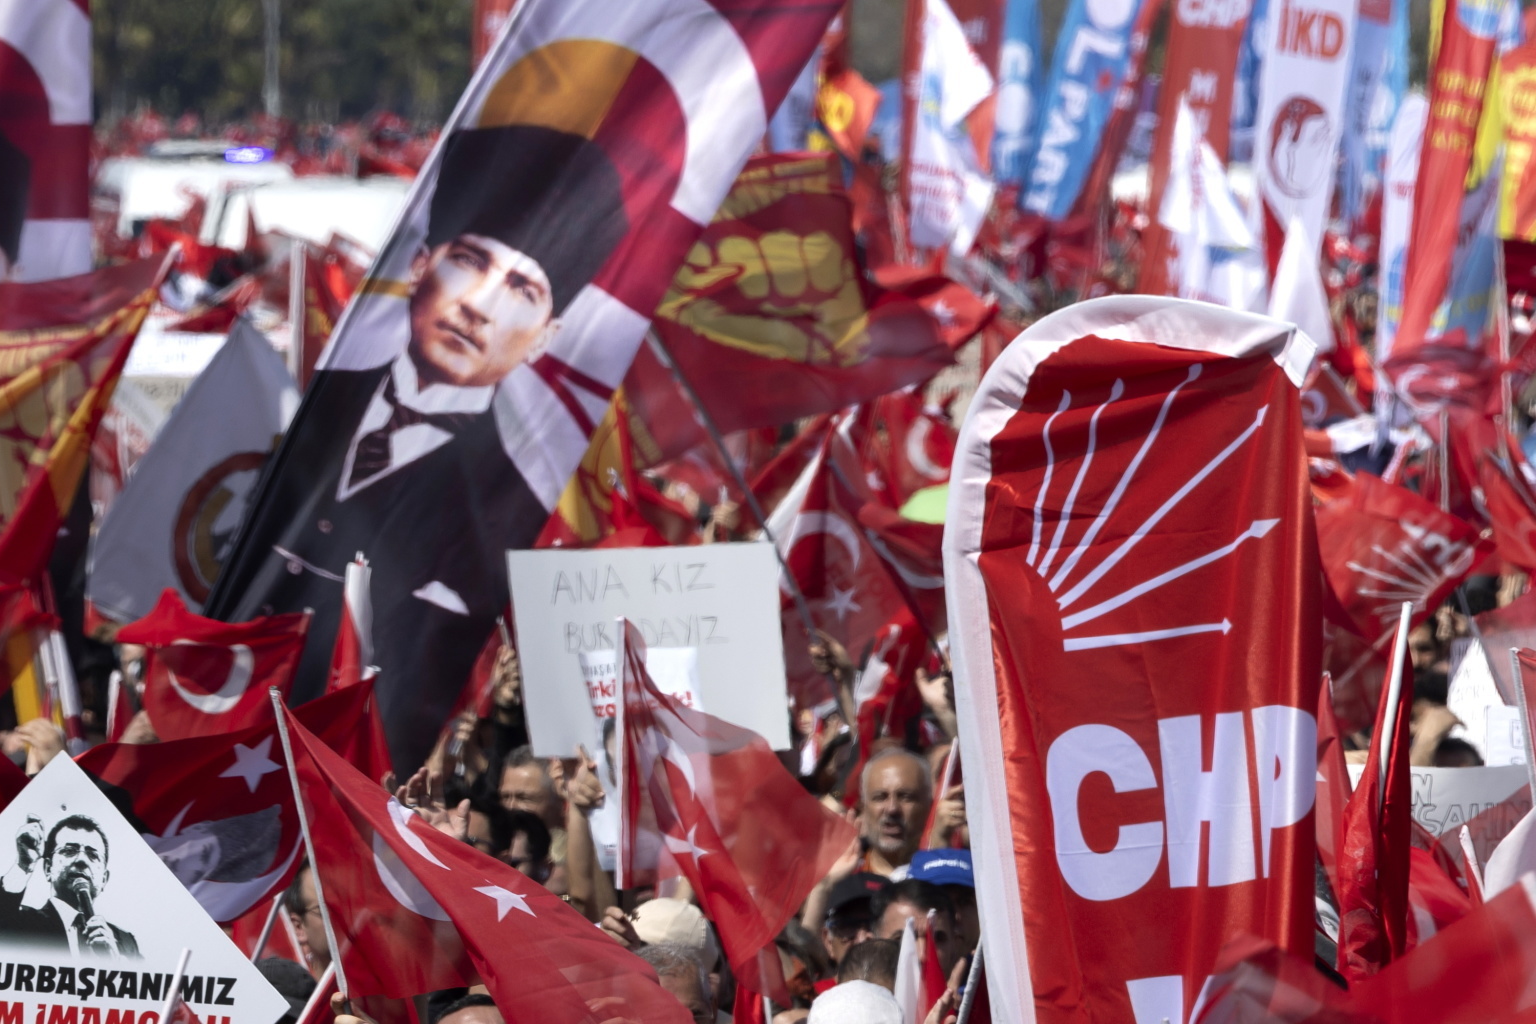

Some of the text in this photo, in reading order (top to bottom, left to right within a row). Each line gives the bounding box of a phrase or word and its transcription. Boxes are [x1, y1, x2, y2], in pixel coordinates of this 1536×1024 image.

[551, 562, 714, 607] ANA KIZ
[565, 614, 729, 655] BURDAYIZ
[1046, 704, 1318, 902] CHP
